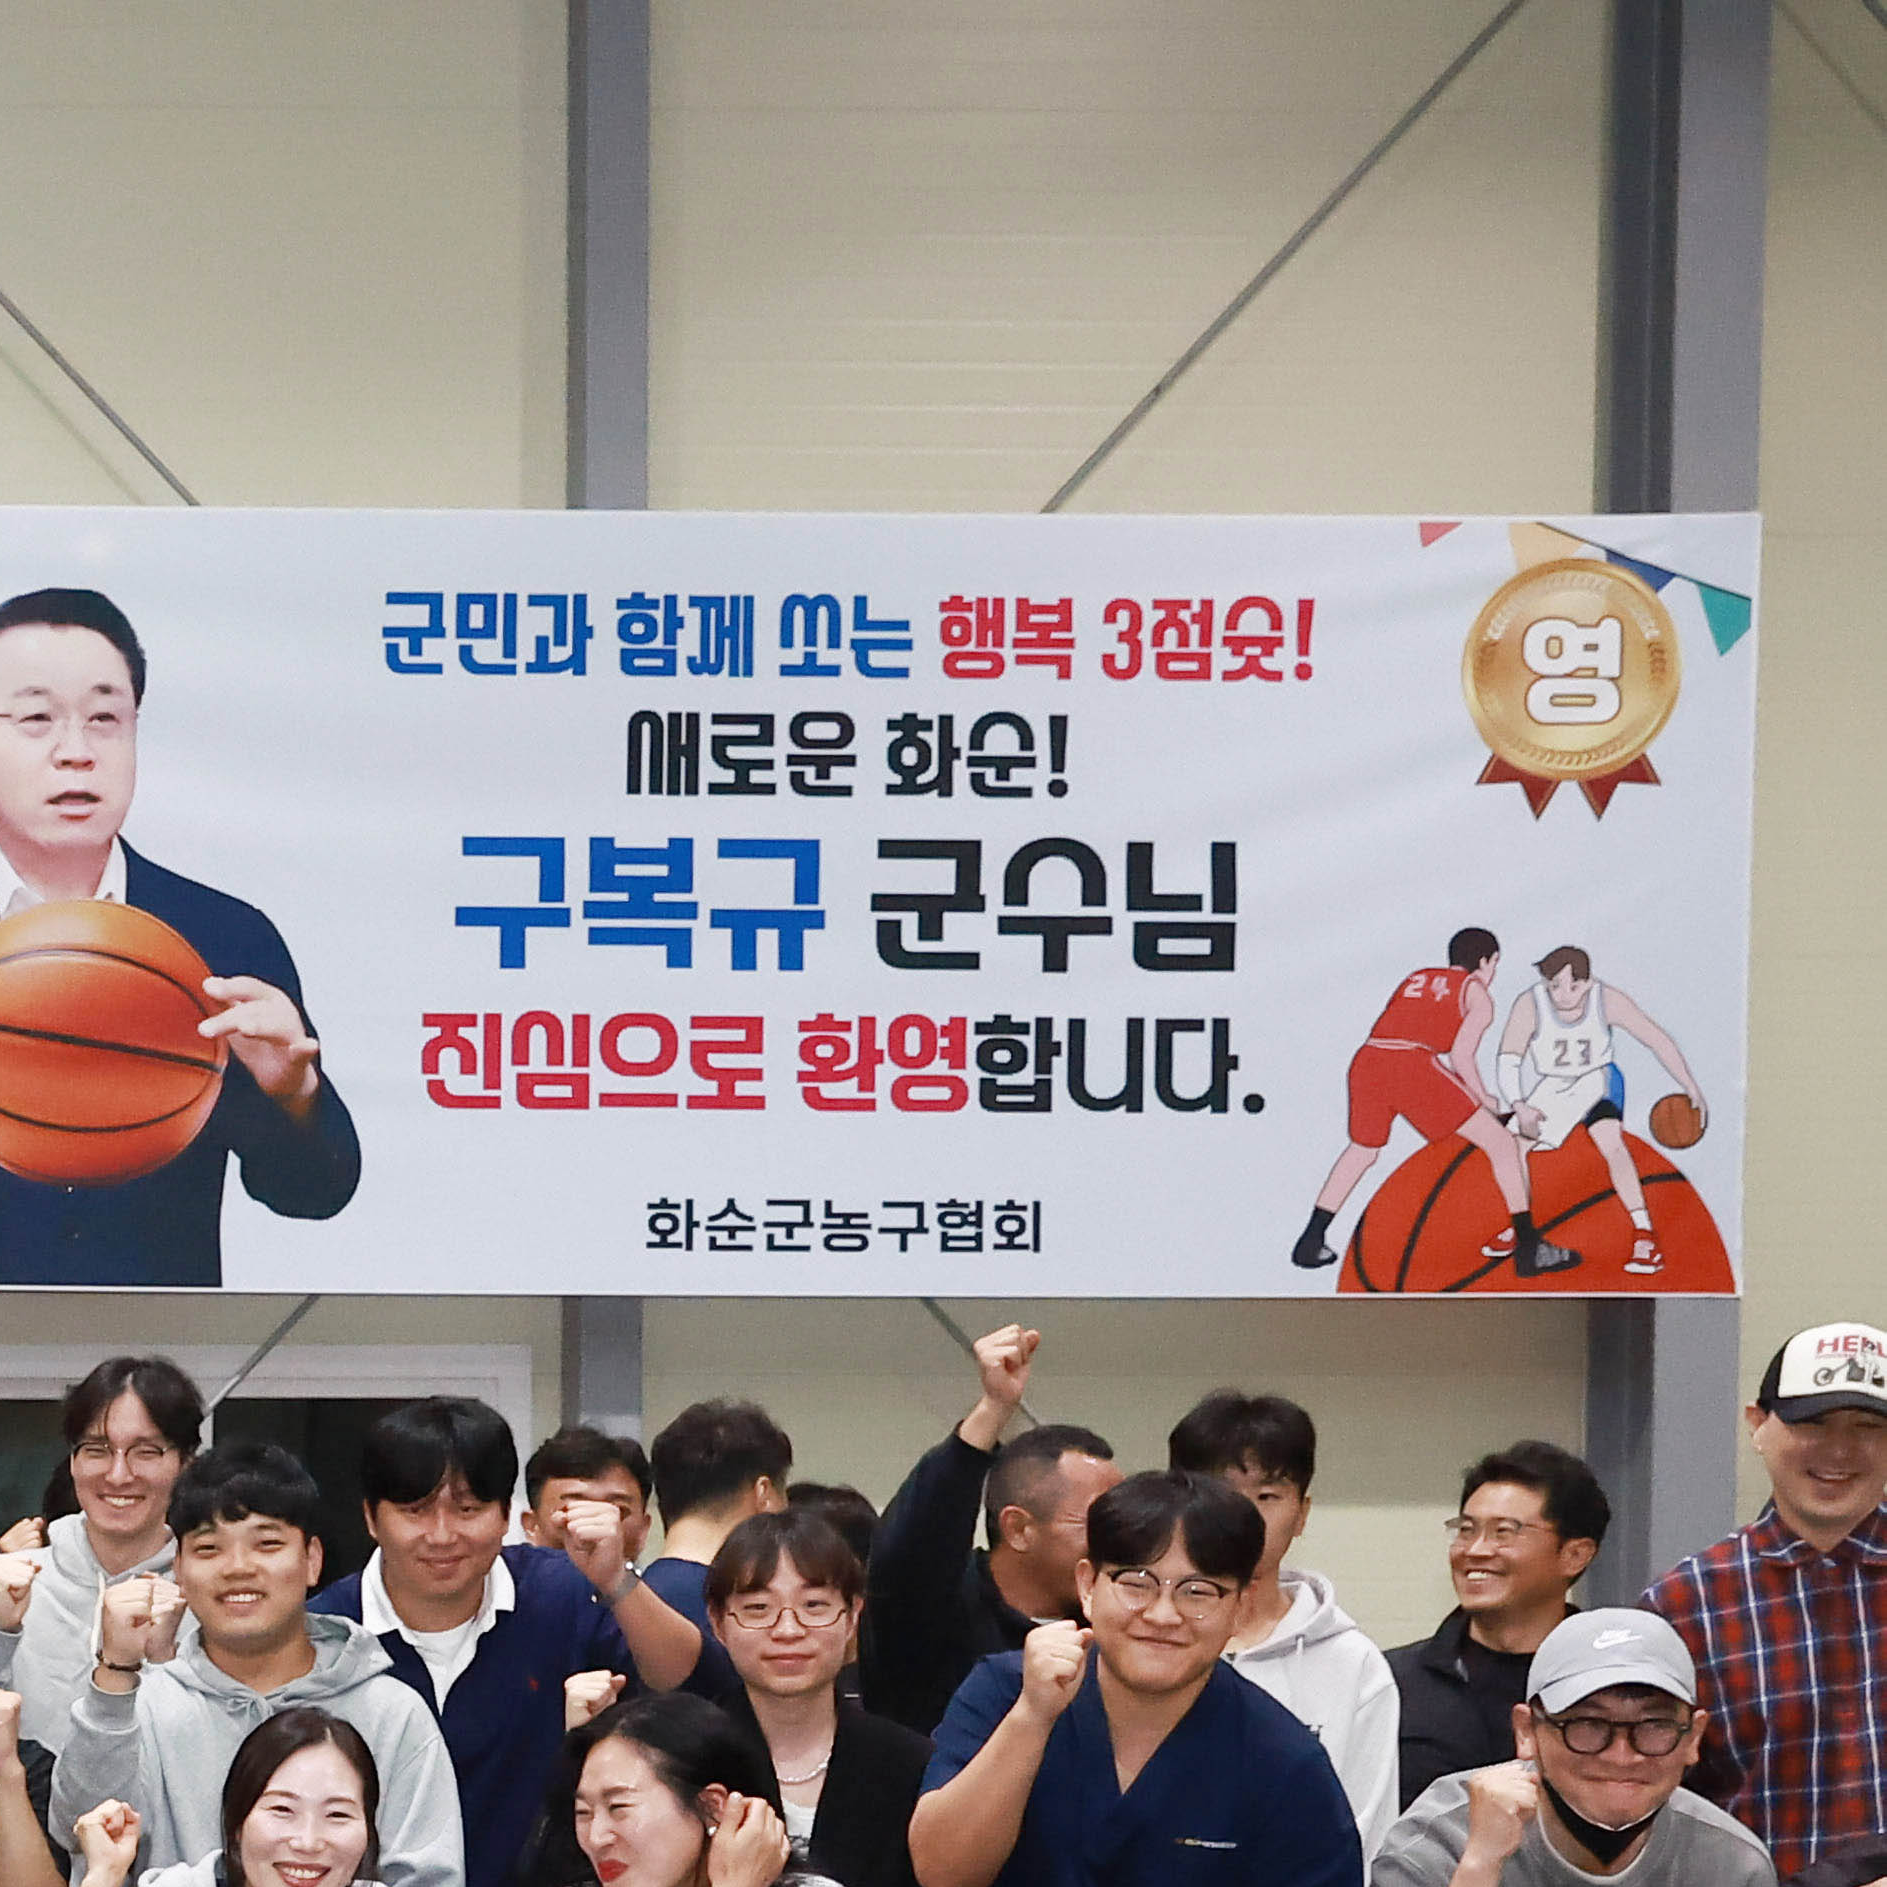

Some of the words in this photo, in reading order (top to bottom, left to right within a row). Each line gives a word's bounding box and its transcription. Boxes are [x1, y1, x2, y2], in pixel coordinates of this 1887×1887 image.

[382, 592, 594, 676] 군민과
[616, 592, 754, 678] 함께
[779, 594, 914, 679] 쓰는
[939, 595, 1076, 680] 행복
[1101, 596, 1315, 682] 3점슛!
[1521, 615, 1623, 725] 영
[626, 710, 857, 797] 새로운
[885, 711, 1068, 798] 화순!
[455, 836, 826, 971] 구복규
[870, 837, 1237, 973] 군수님
[421, 1010, 766, 1110] 진심으로
[797, 1011, 1265, 1114] 환영합니다.
[1553, 1038, 1591, 1067] 23
[646, 1197, 1041, 1253] 화순군농구협회
